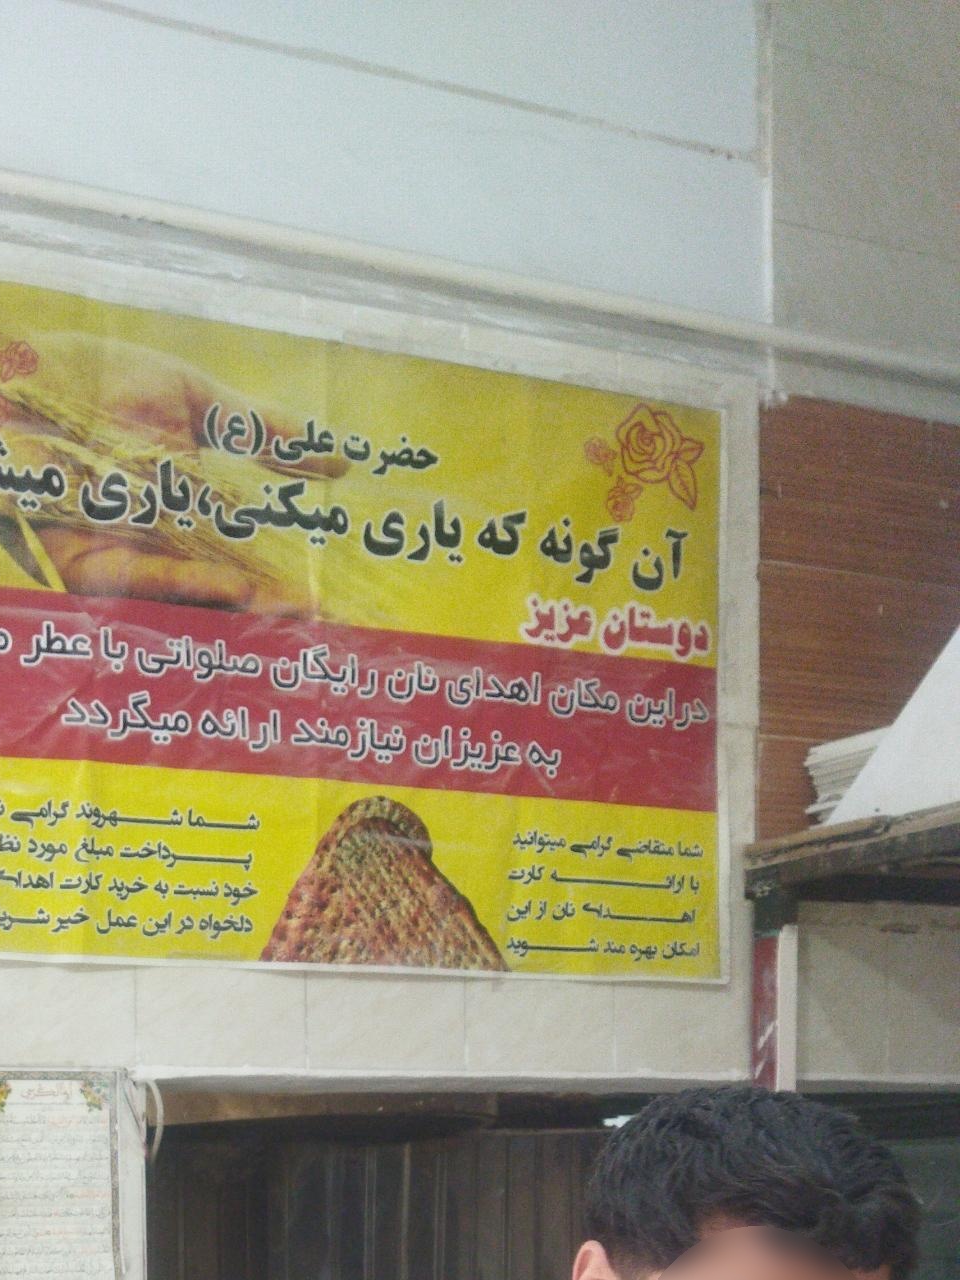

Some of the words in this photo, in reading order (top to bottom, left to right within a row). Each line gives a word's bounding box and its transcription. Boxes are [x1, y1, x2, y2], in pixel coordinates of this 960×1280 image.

[204, 403, 265, 456] (ع)
[272, 418, 335, 463] علی
[342, 434, 439, 476] حضرت
[80, 459, 192, 529] یاری
[363, 500, 464, 565] یاری
[477, 510, 528, 557] که
[539, 516, 620, 584] گونه
[630, 527, 689, 591] آن
[523, 593, 597, 647] عزیز
[601, 601, 710, 659] دوستان
[20, 621, 92, 666] عطر
[100, 626, 128, 672] با
[136, 635, 262, 680] صلواتی
[271, 644, 378, 698] رایگان
[387, 661, 439, 701] نان
[445, 668, 541, 707] اهدای
[549, 677, 620, 718] مکان
[61, 691, 191, 744] میگردد
[197, 704, 282, 752] ارائه
[292, 717, 407, 763] نیازمند
[413, 725, 521, 772] عزیزان
[527, 742, 561, 778] به
[10, 799, 70, 829] گرامی
[77, 803, 184, 829] شهروند
[187, 808, 261, 831] شما
[27, 838, 68, 862] مورد
[74, 836, 115, 864] مبلغ
[512, 830, 567, 853] میتوانید
[569, 835, 614, 858] گرامی
[616, 838, 676, 862] متقاضی
[677, 840, 704, 858] شما
[119, 840, 254, 872] پرداخت
[58, 872, 103, 895] کارت
[152, 877, 169, 899] به
[508, 864, 545, 885] کارت
[689, 874, 700, 895] با
[107, 876, 149, 902] خرید
[172, 880, 219, 899] نسبت
[223, 881, 259, 907] خود
[52, 906, 91, 933] خیر
[95, 907, 138, 935] عمل
[141, 911, 173, 938] این
[176, 914, 195, 934] در
[506, 899, 532, 922] این
[534, 900, 548, 921] از
[551, 900, 576, 921] نان
[197, 915, 255, 940] دلخواه
[506, 936, 600, 958] شوید
[603, 940, 626, 955] مند
[629, 943, 658, 961] بهره
[662, 940, 701, 960] امکان
